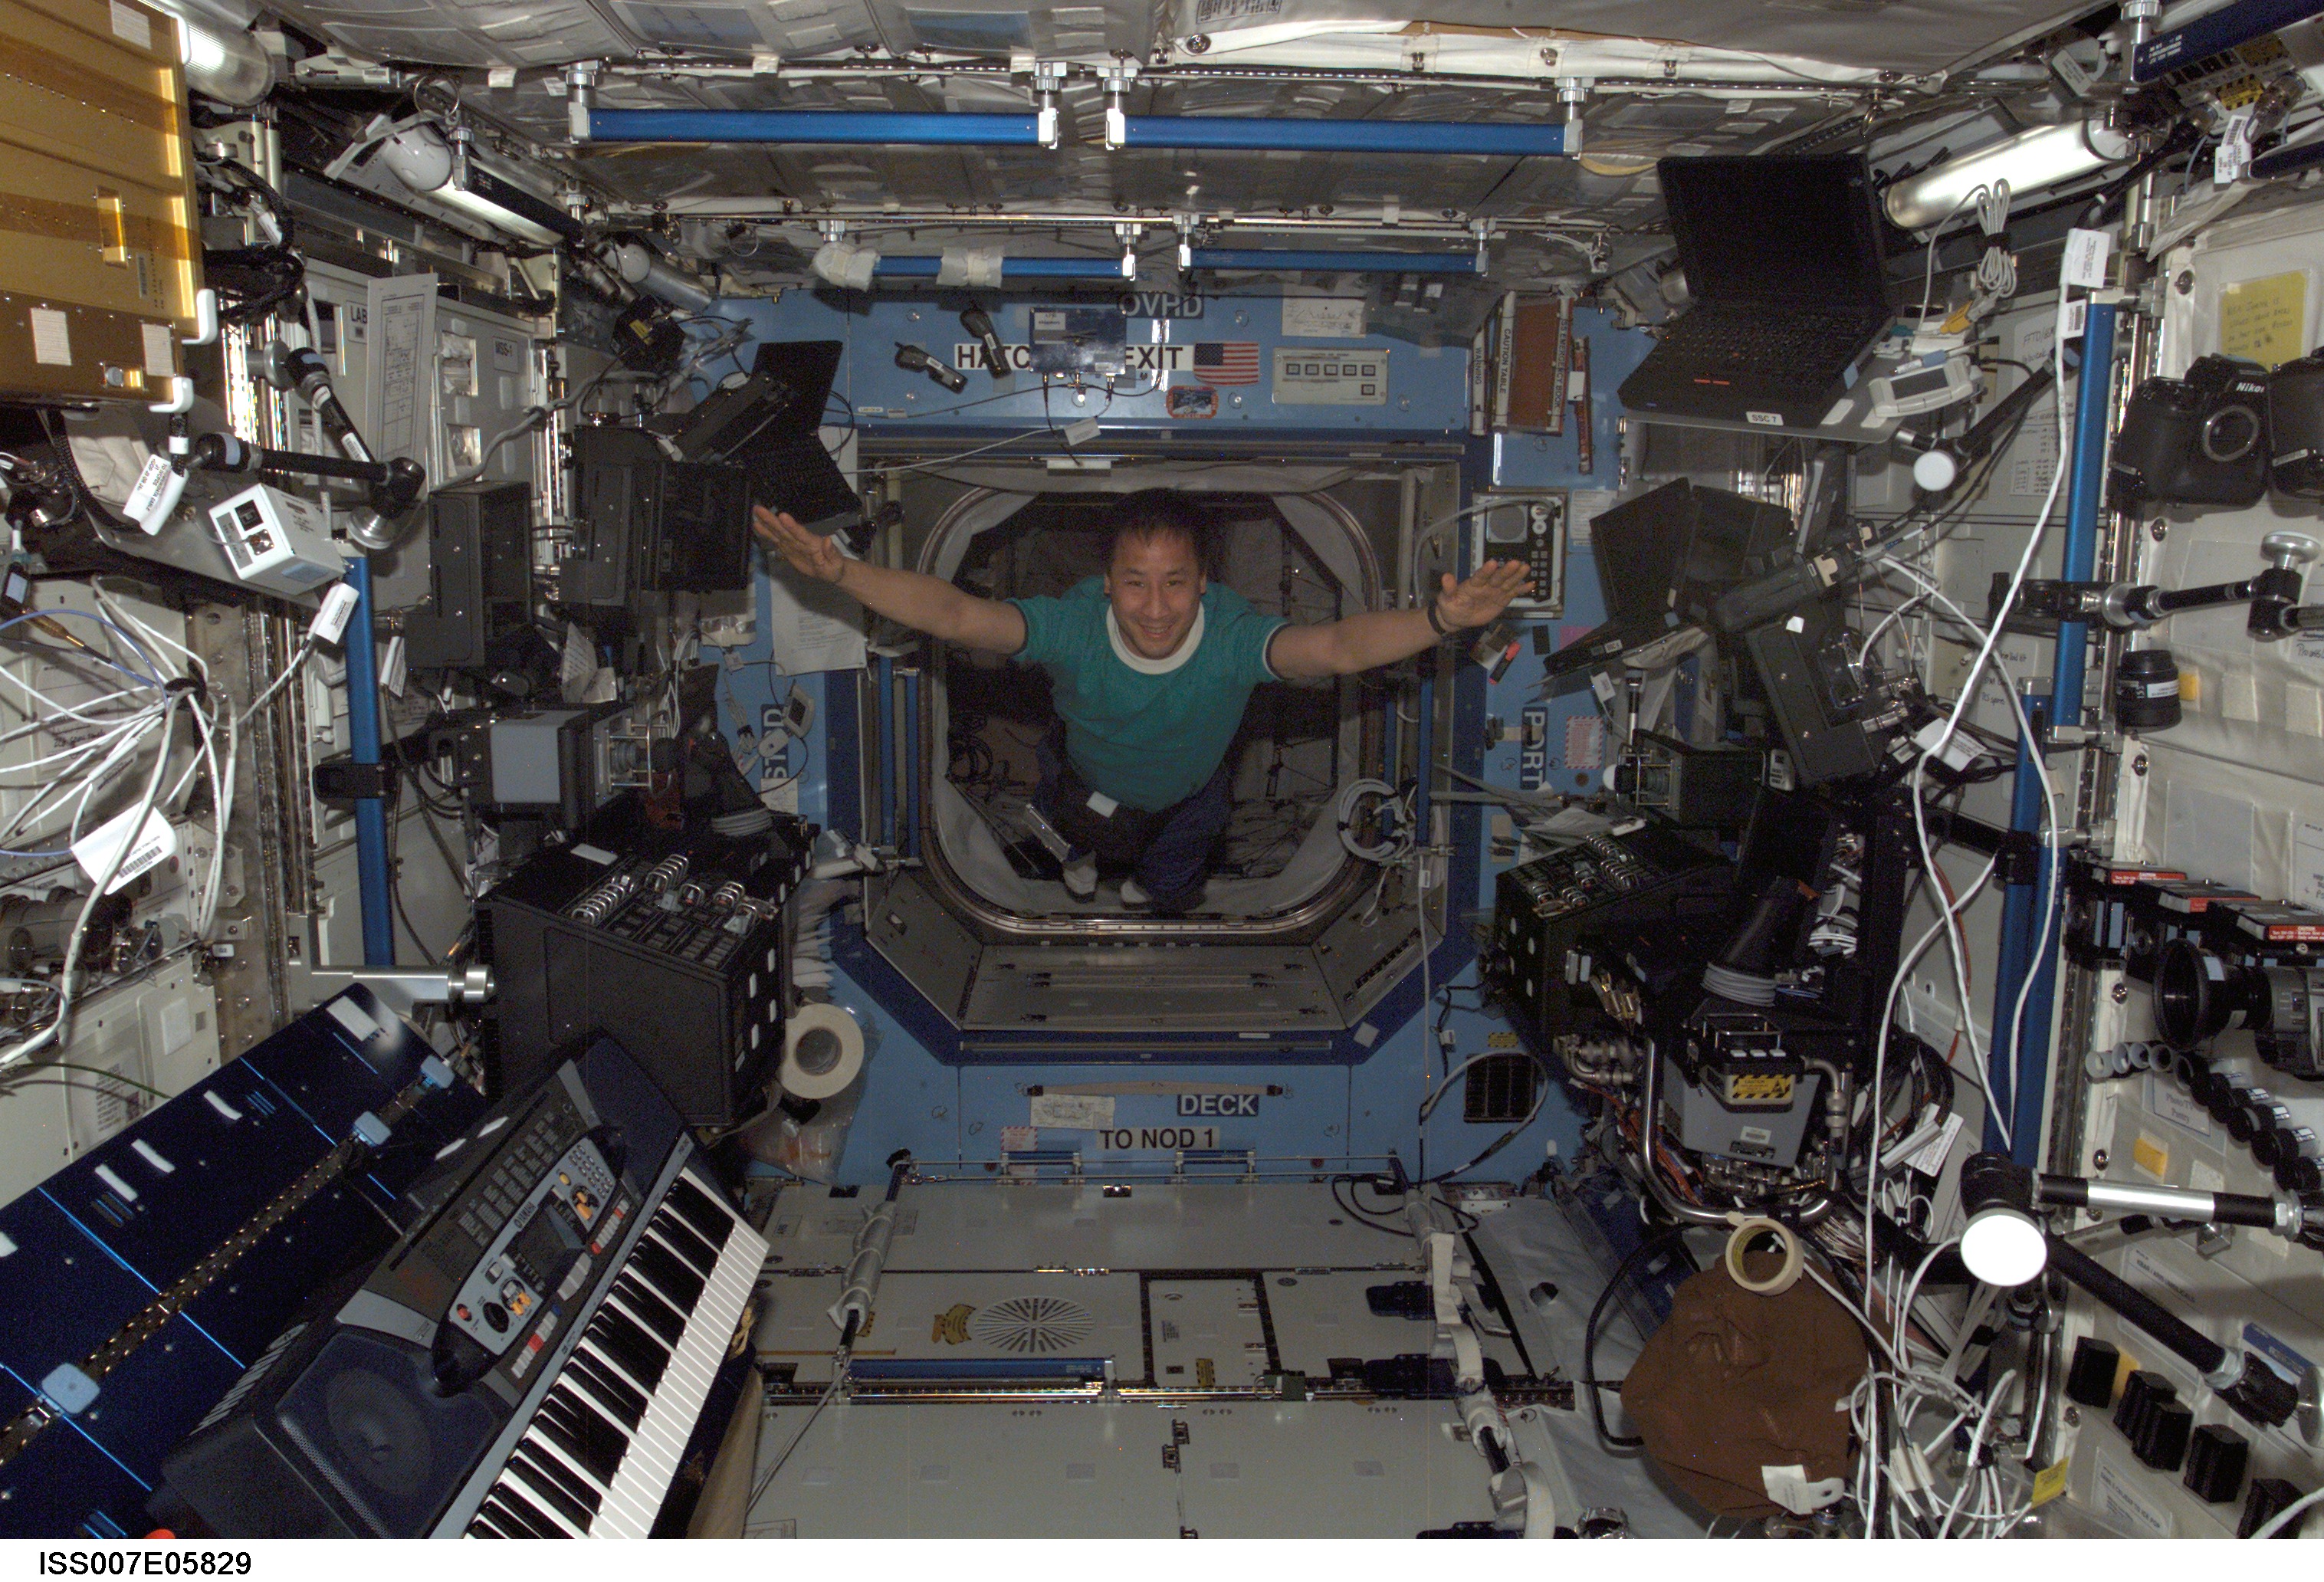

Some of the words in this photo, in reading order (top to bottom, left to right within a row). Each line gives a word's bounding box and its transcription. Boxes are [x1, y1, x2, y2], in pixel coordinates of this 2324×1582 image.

[1120, 295, 1202, 316] OVHD
[1501, 328, 1512, 366] CAUTION
[1556, 333, 1566, 384] EMERGENCY
[1554, 386, 1562, 409] BOOK
[1751, 414, 1770, 422] SSC
[764, 708, 787, 778] STD
[1180, 1095, 1257, 1115] DECK
[1099, 1129, 1133, 1150] TO
[1142, 1128, 1196, 1150] NOD
[1204, 1128, 1213, 1148] 1
